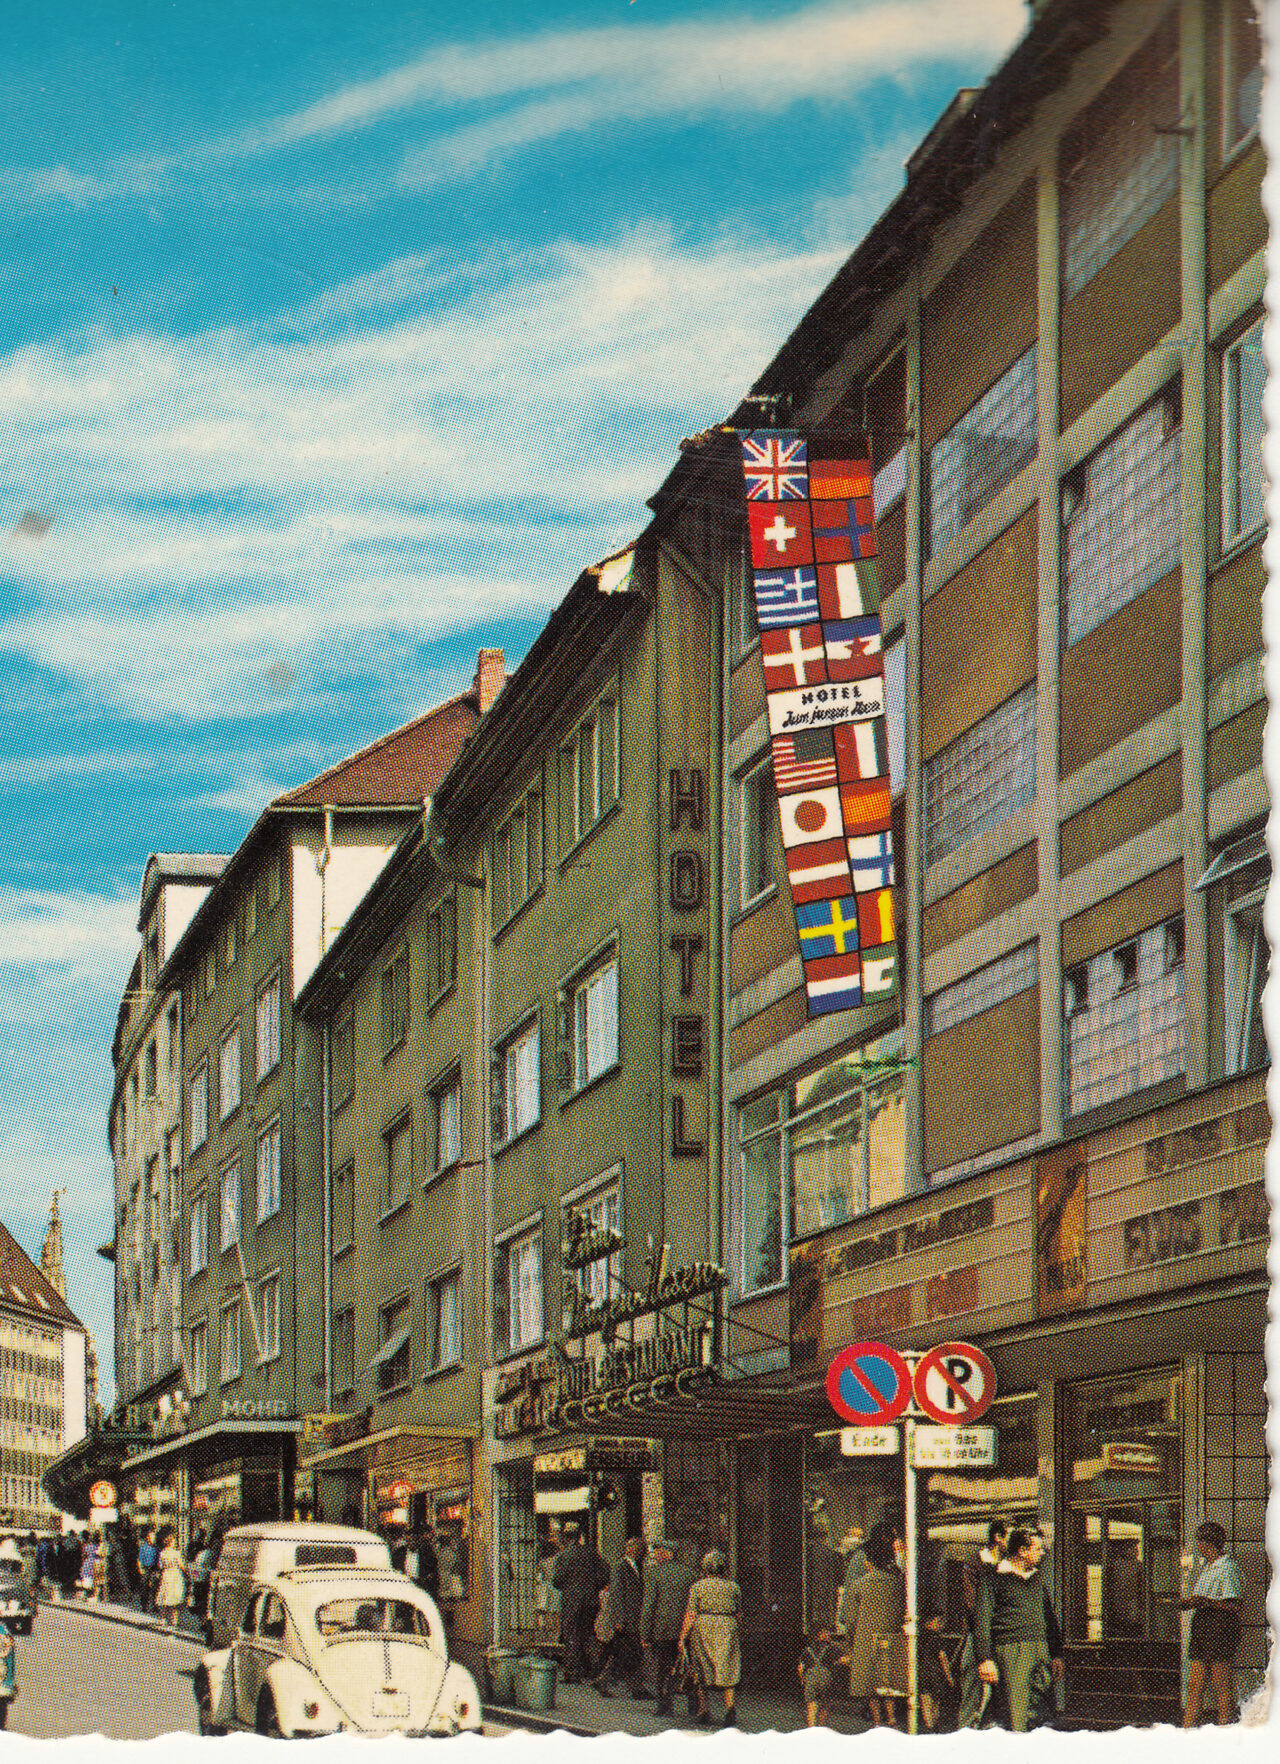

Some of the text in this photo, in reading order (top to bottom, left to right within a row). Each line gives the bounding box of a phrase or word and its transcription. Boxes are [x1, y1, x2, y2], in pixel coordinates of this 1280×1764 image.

[802, 685, 862, 706] HOTEL
[669, 768, 703, 1157] HOTEL
[221, 1399, 289, 1418] MOHR
[852, 1433, 889, 1448] Ende
